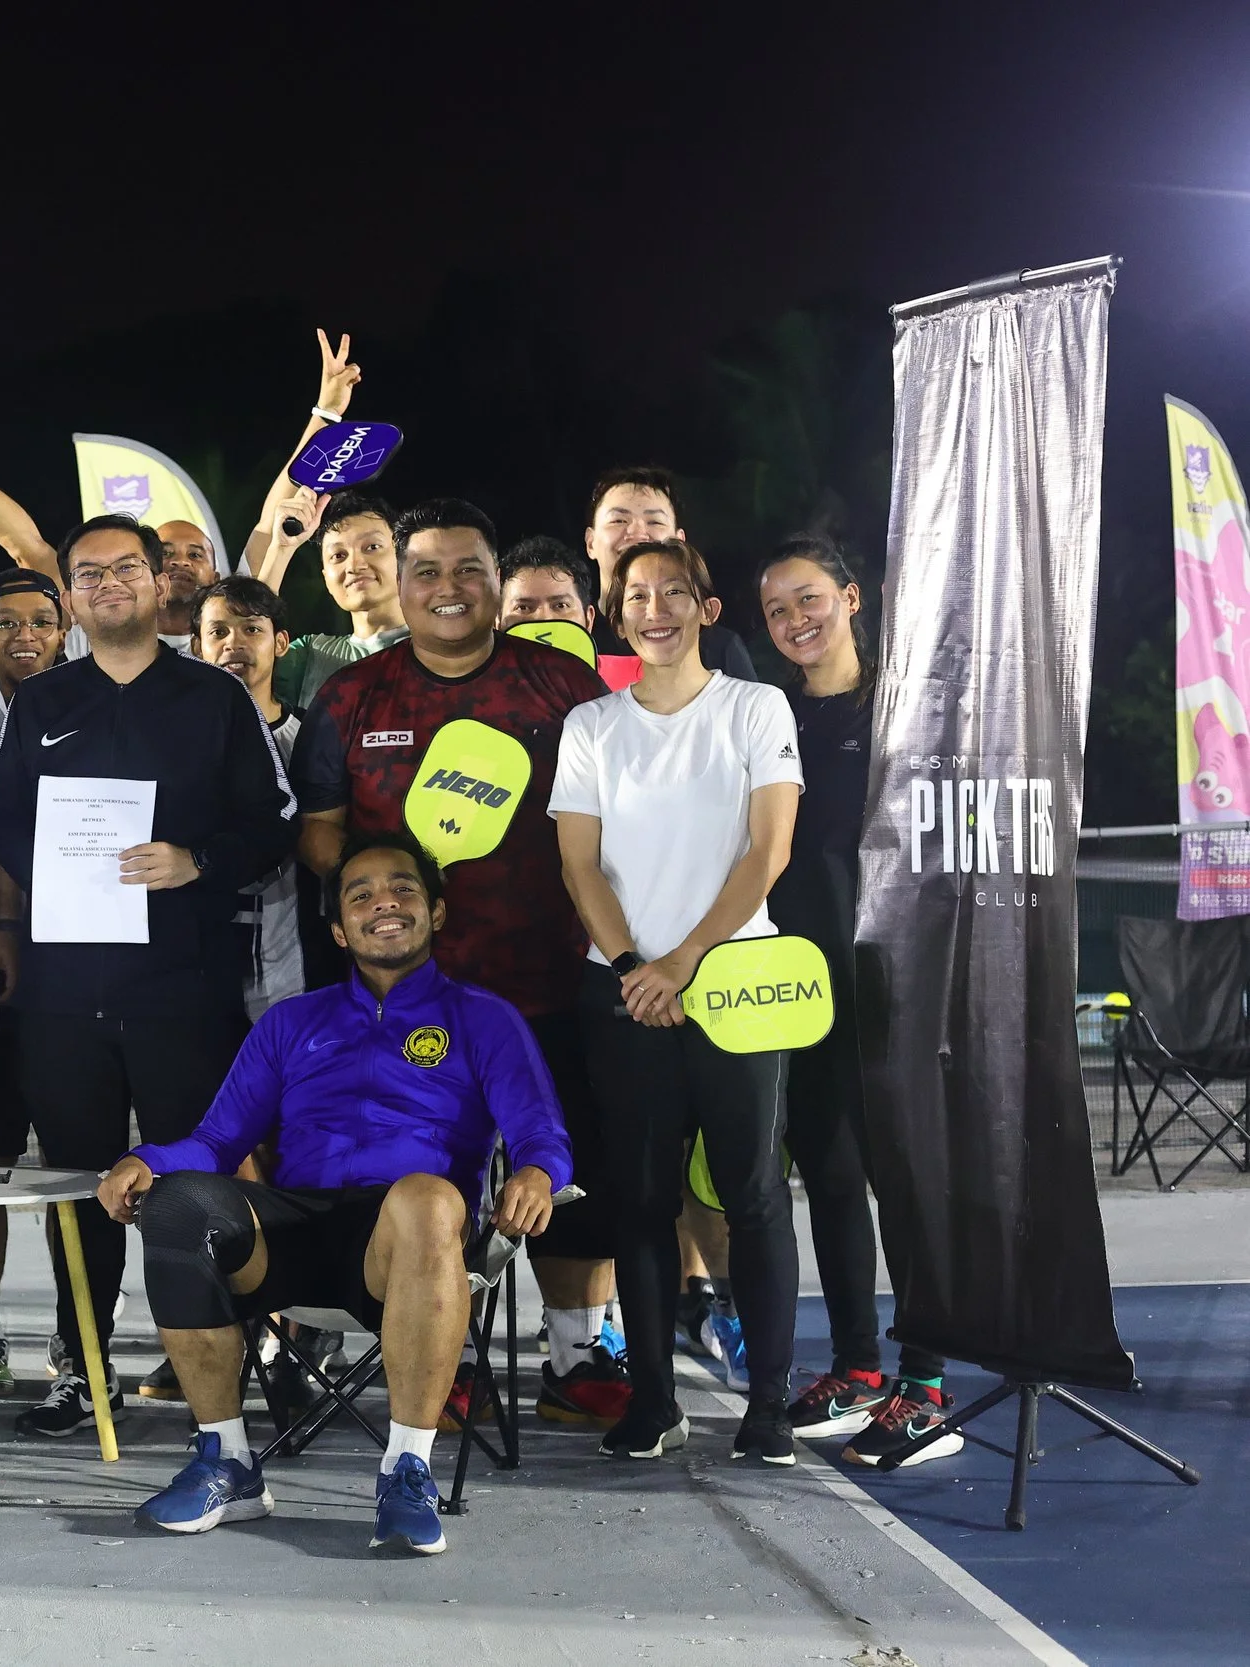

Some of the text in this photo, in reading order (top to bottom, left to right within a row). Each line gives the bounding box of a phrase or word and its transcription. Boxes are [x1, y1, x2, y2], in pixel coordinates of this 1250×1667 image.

[318, 427, 371, 482] DIADEM
[366, 734, 408, 744] ZLRD
[910, 755, 966, 770] ESM
[422, 768, 512, 808] HERO
[976, 892, 1038, 907] CLUB
[706, 980, 822, 1010] DIADEM
